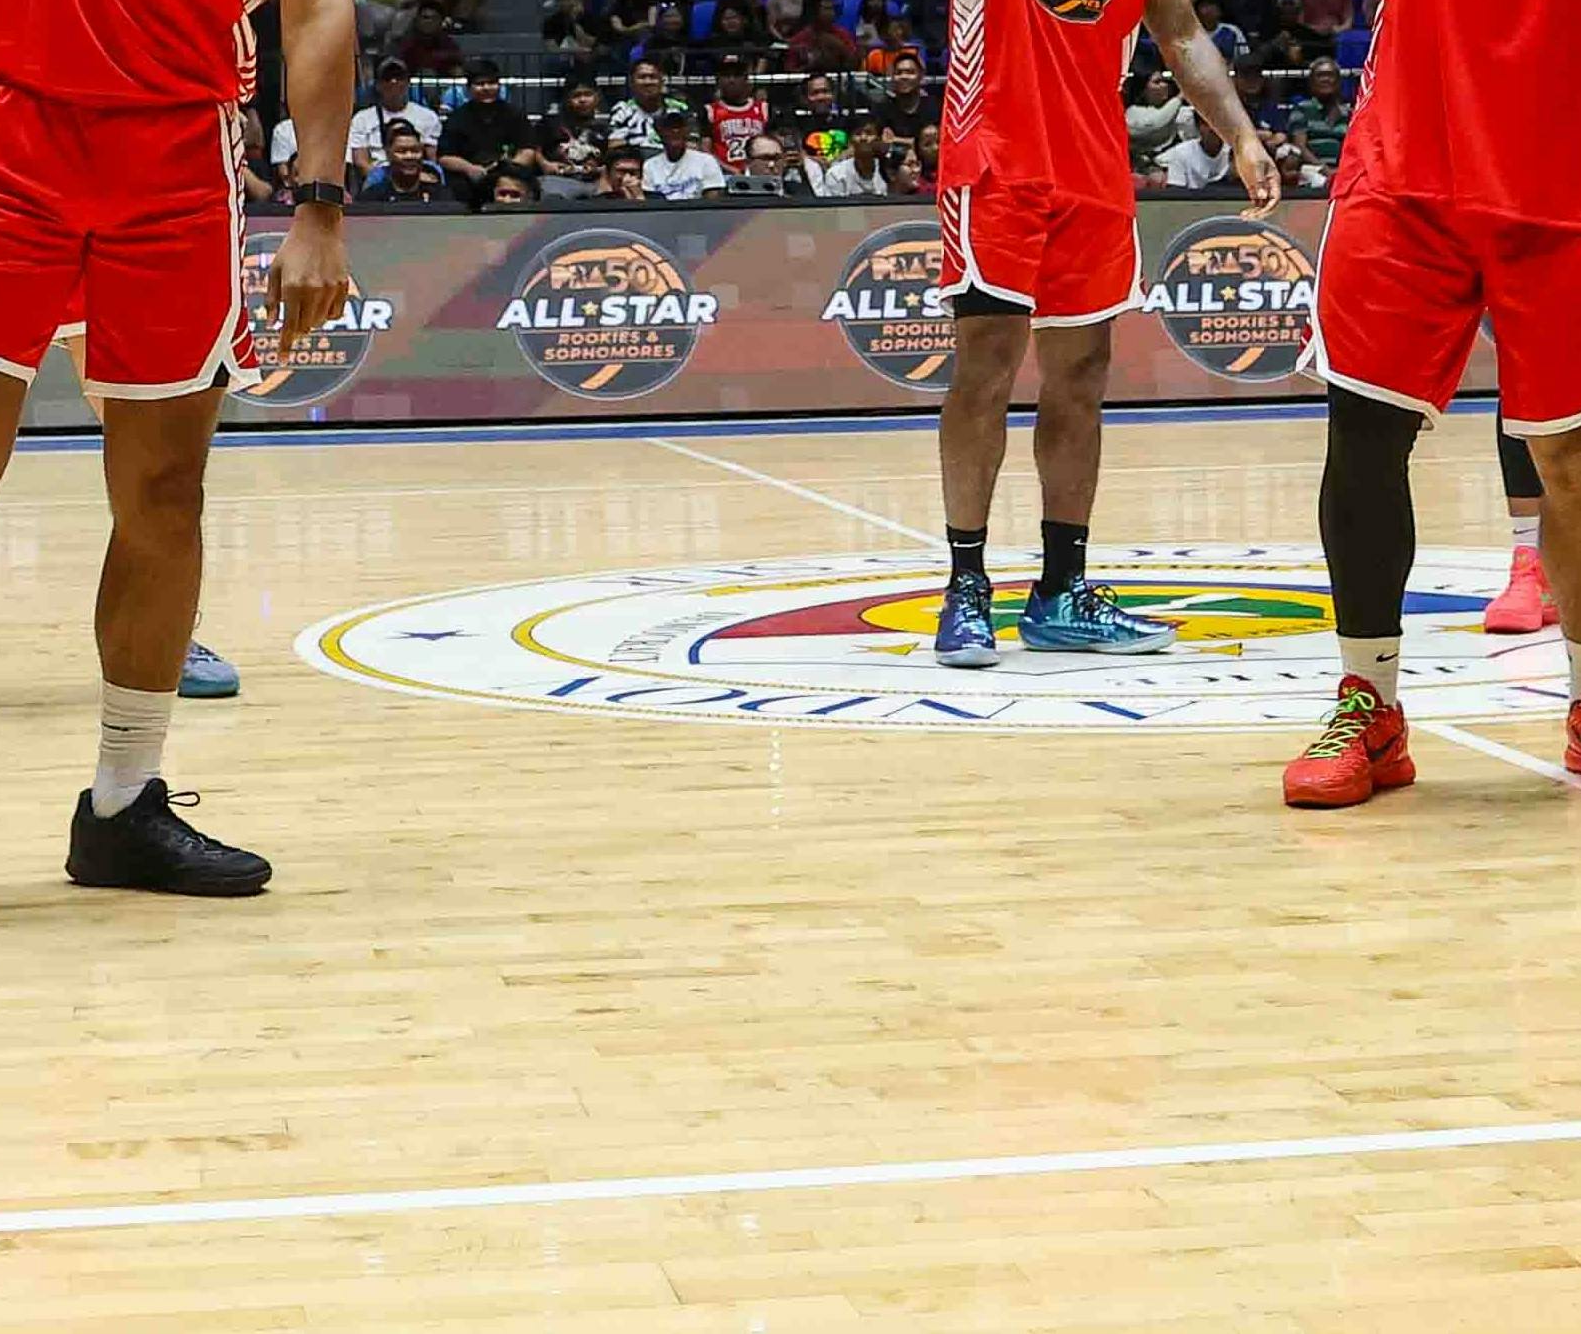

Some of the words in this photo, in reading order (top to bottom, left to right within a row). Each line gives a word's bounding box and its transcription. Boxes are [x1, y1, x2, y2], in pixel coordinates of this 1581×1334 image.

[822, 289, 908, 320] ALL
[1142, 282, 1225, 312] ALL
[1237, 280, 1313, 311] STA
[496, 297, 586, 329] ALL
[599, 294, 718, 326] STAR
[1201, 317, 1280, 329] ROOKIES
[1285, 317, 1296, 327] &
[557, 331, 641, 346] ROOKIES
[646, 331, 660, 343] &
[1189, 328, 1301, 344] SOPHOMORE
[544, 344, 676, 361] SOPHOMORES
